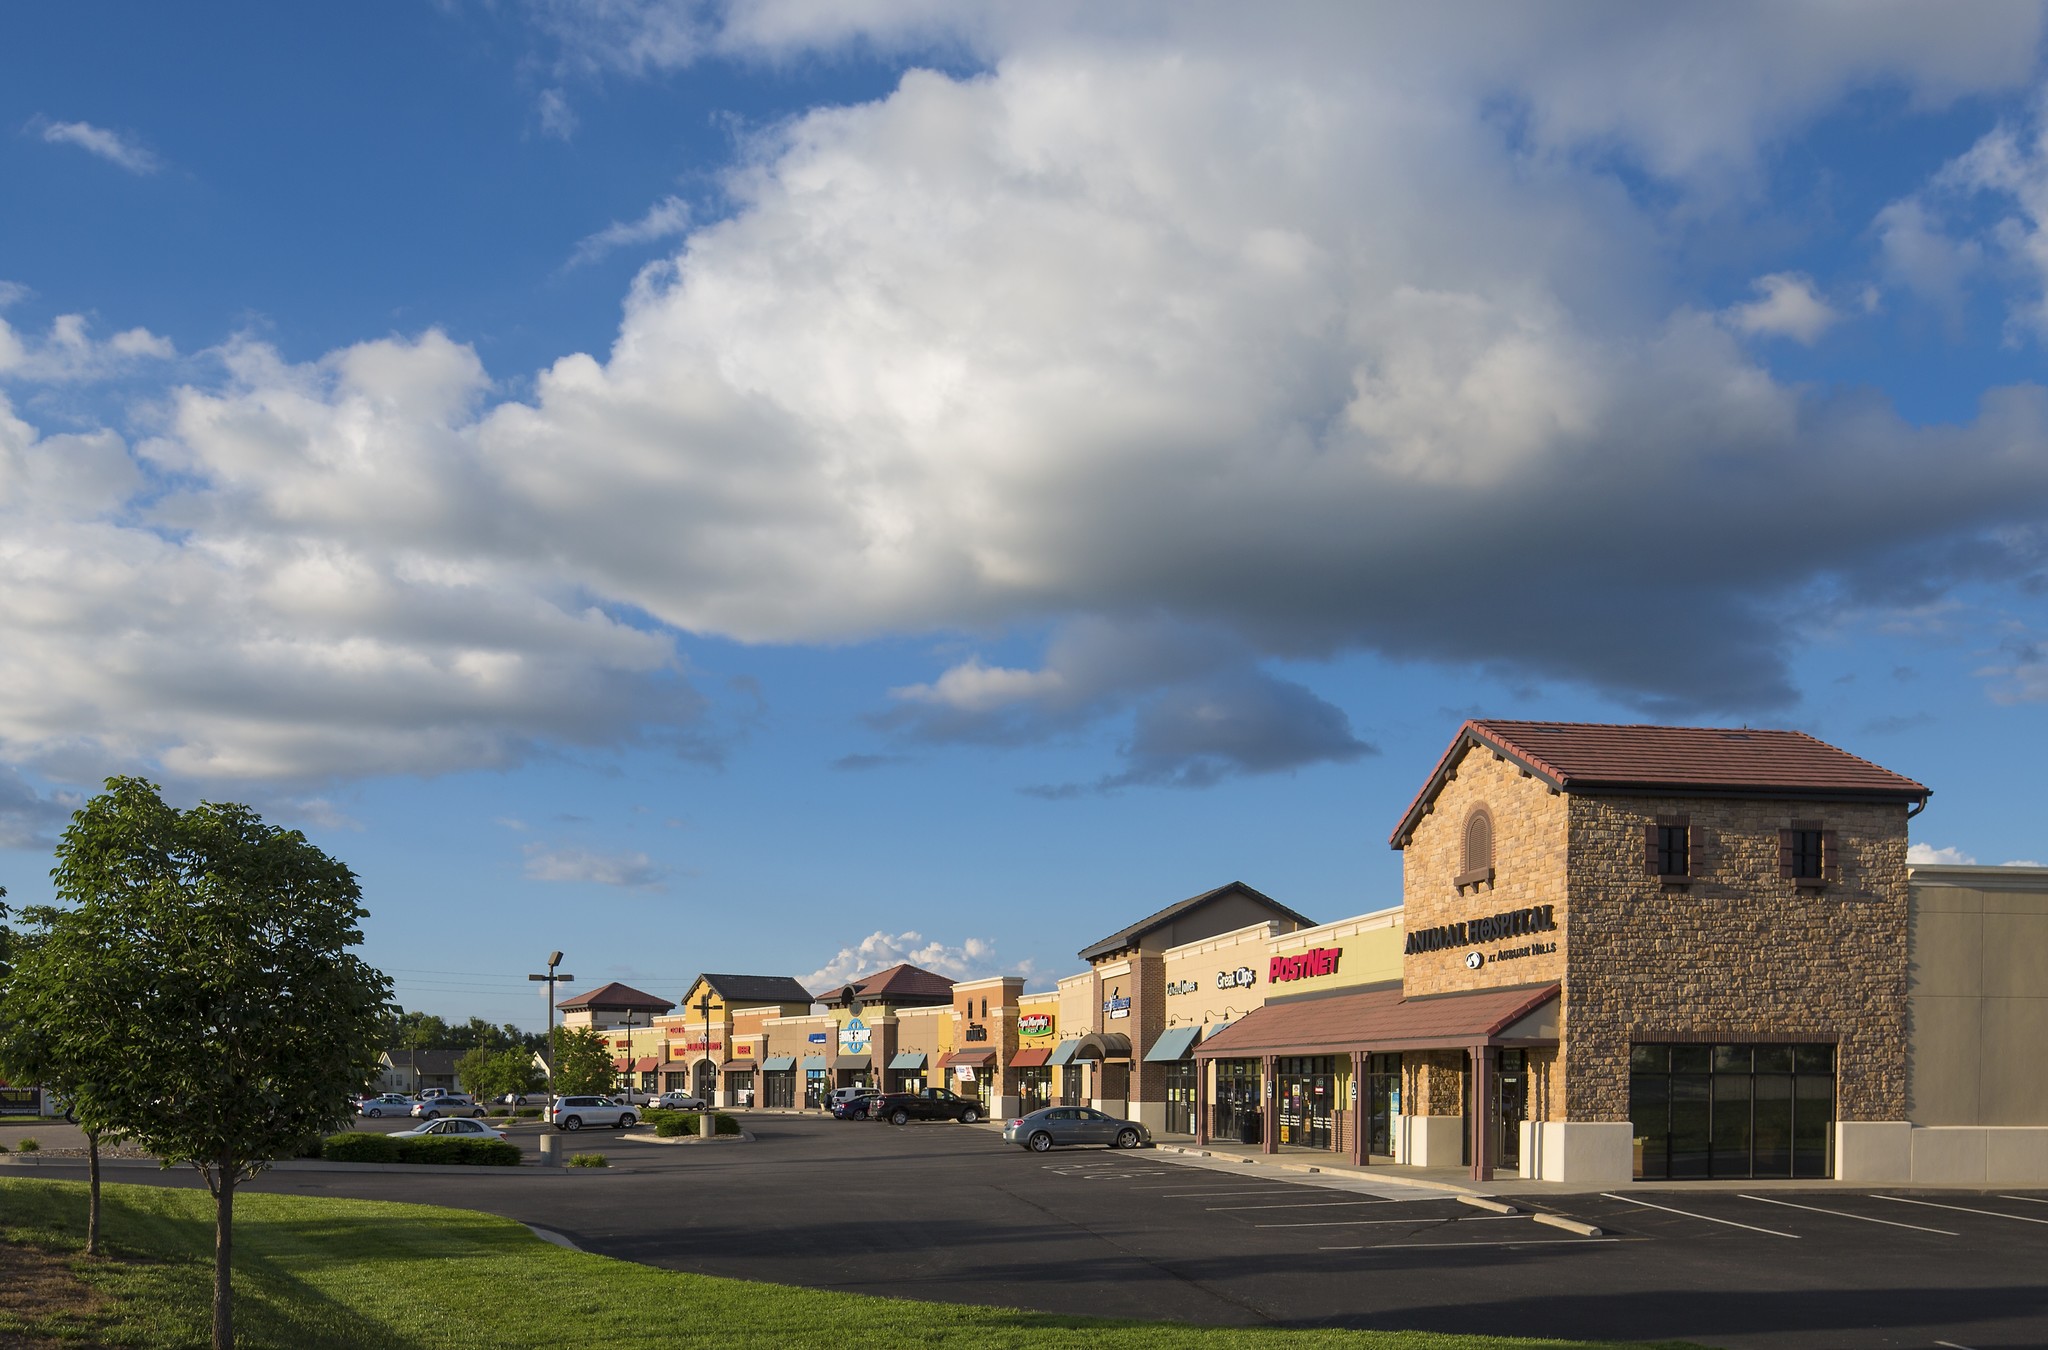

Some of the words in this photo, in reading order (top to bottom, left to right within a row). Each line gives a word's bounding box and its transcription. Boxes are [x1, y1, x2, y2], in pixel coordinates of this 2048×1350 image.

[1404, 922, 1468, 955] ANIMAL
[1467, 904, 1557, 944] HOSPITAL
[1216, 970, 1236, 989] Great
[1236, 966, 1256, 989] Clips
